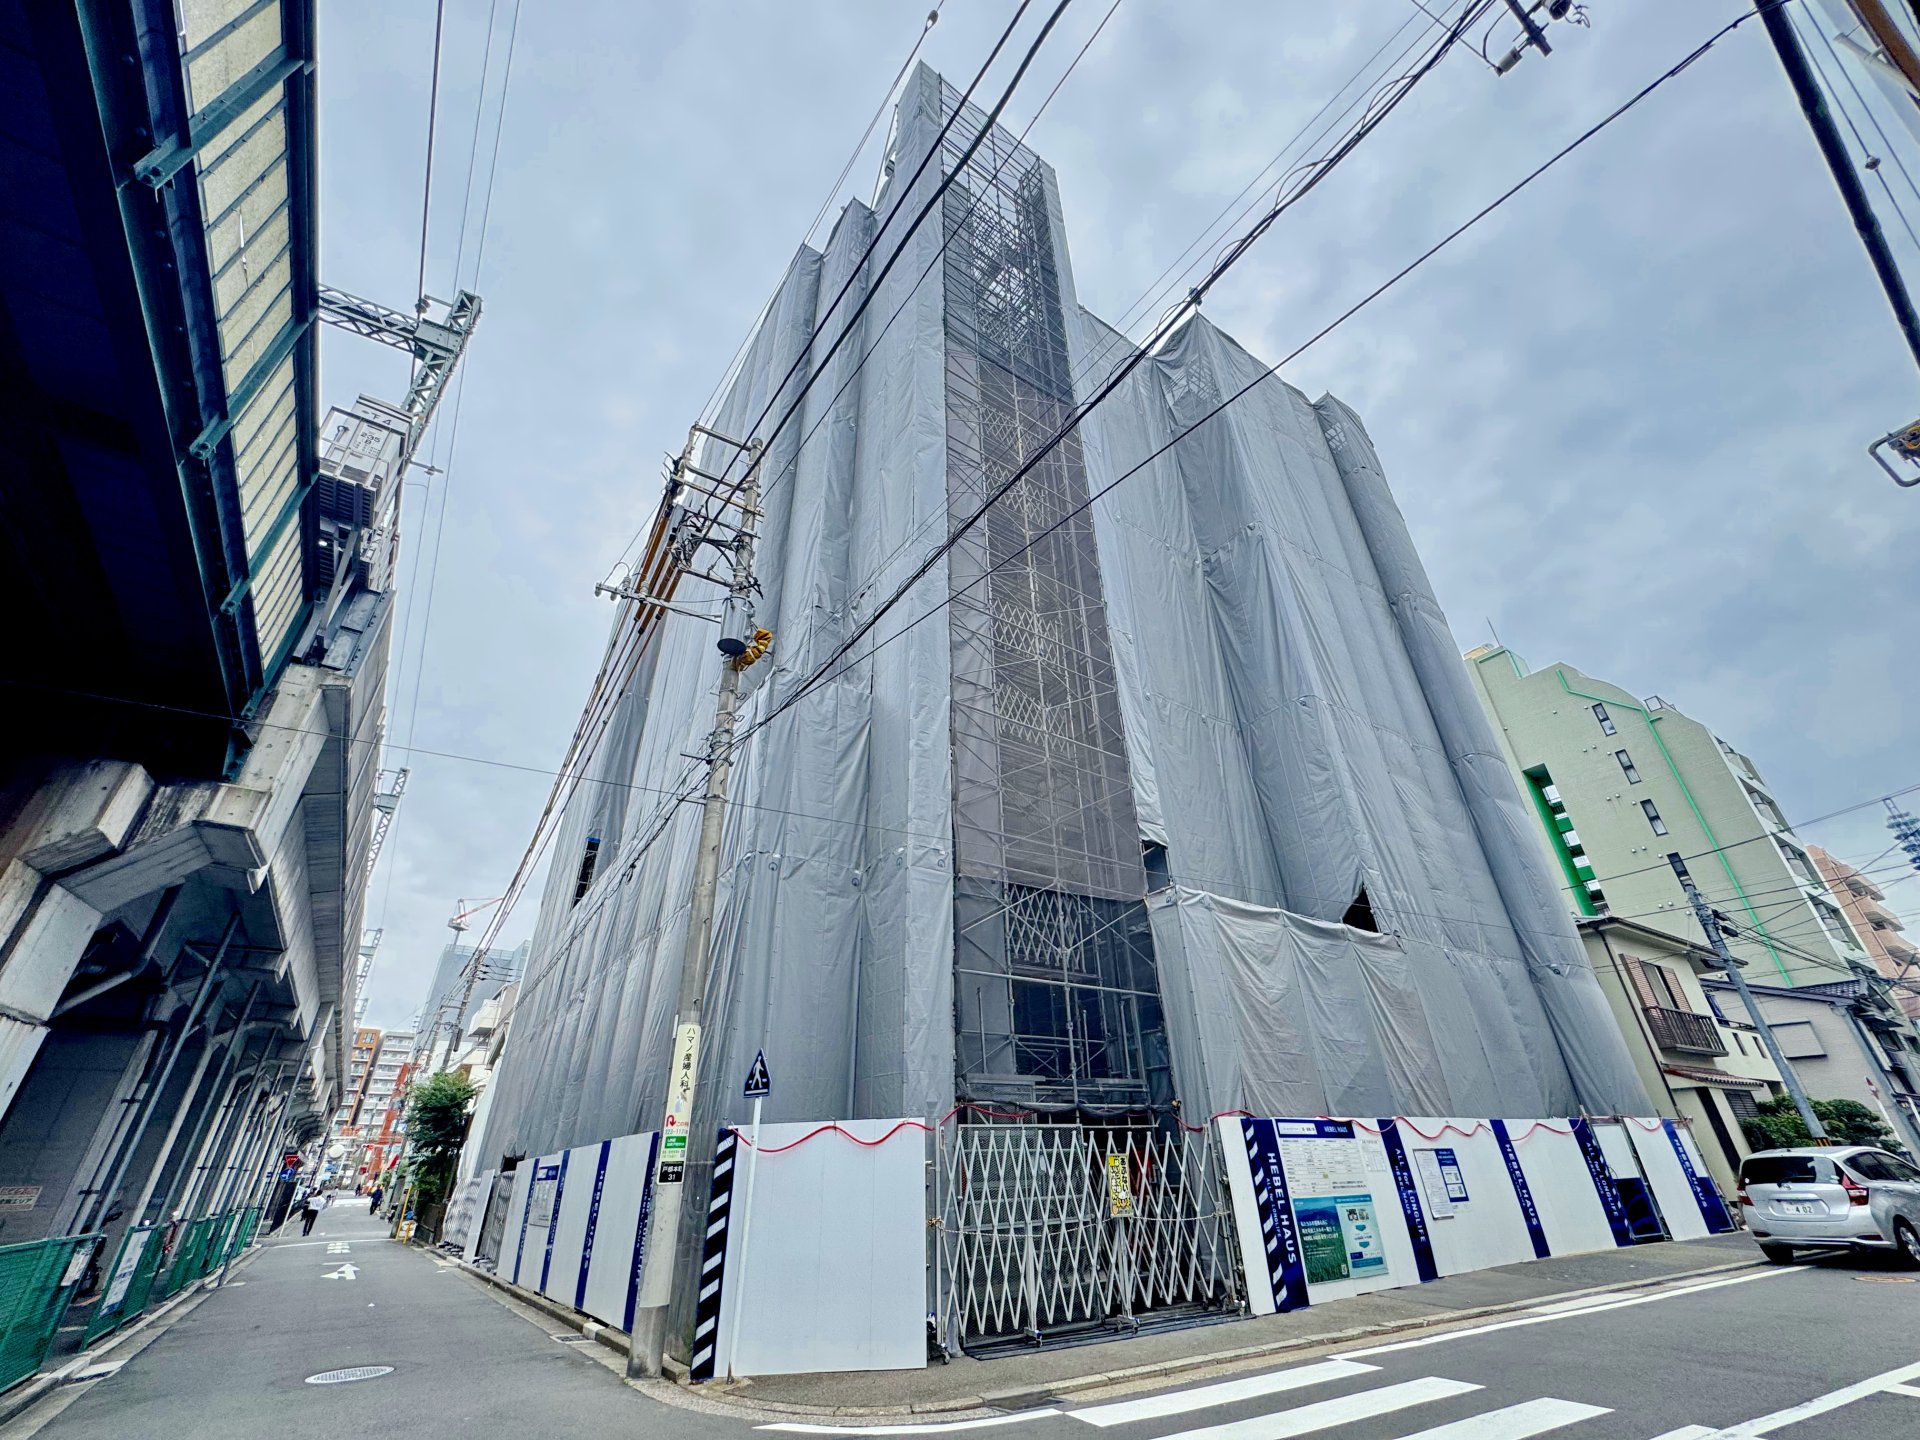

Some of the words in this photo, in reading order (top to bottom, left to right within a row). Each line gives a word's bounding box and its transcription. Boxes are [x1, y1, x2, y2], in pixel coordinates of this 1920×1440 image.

[680, 1027, 696, 1088] ハマノ産婦人科
[592, 1170, 605, 1221] HEBEL
[661, 1165, 683, 1173] 戸部本町
[1395, 1166, 1404, 1191] HEBEL
[1402, 1193, 1411, 1214] HAUS
[1395, 1148, 1405, 1167] ALL
[1402, 1171, 1410, 1186] for
[1407, 1190, 1427, 1242] LONGLIFE
[1505, 1144, 1523, 1186] HEBEL
[1522, 1189, 1539, 1225] HAUS
[1586, 1142, 1595, 1156] ALL
[1599, 1174, 1619, 1217] LONGLIFE
[1674, 1138, 1693, 1175] HEBEL
[1692, 1177, 1708, 1208] HAUS
[1267, 1152, 1286, 1210] HEBEL
[1280, 1214, 1297, 1264] HAUS
[1272, 1204, 1282, 1238] LONGLIFE
[584, 1225, 595, 1269] HAUS
